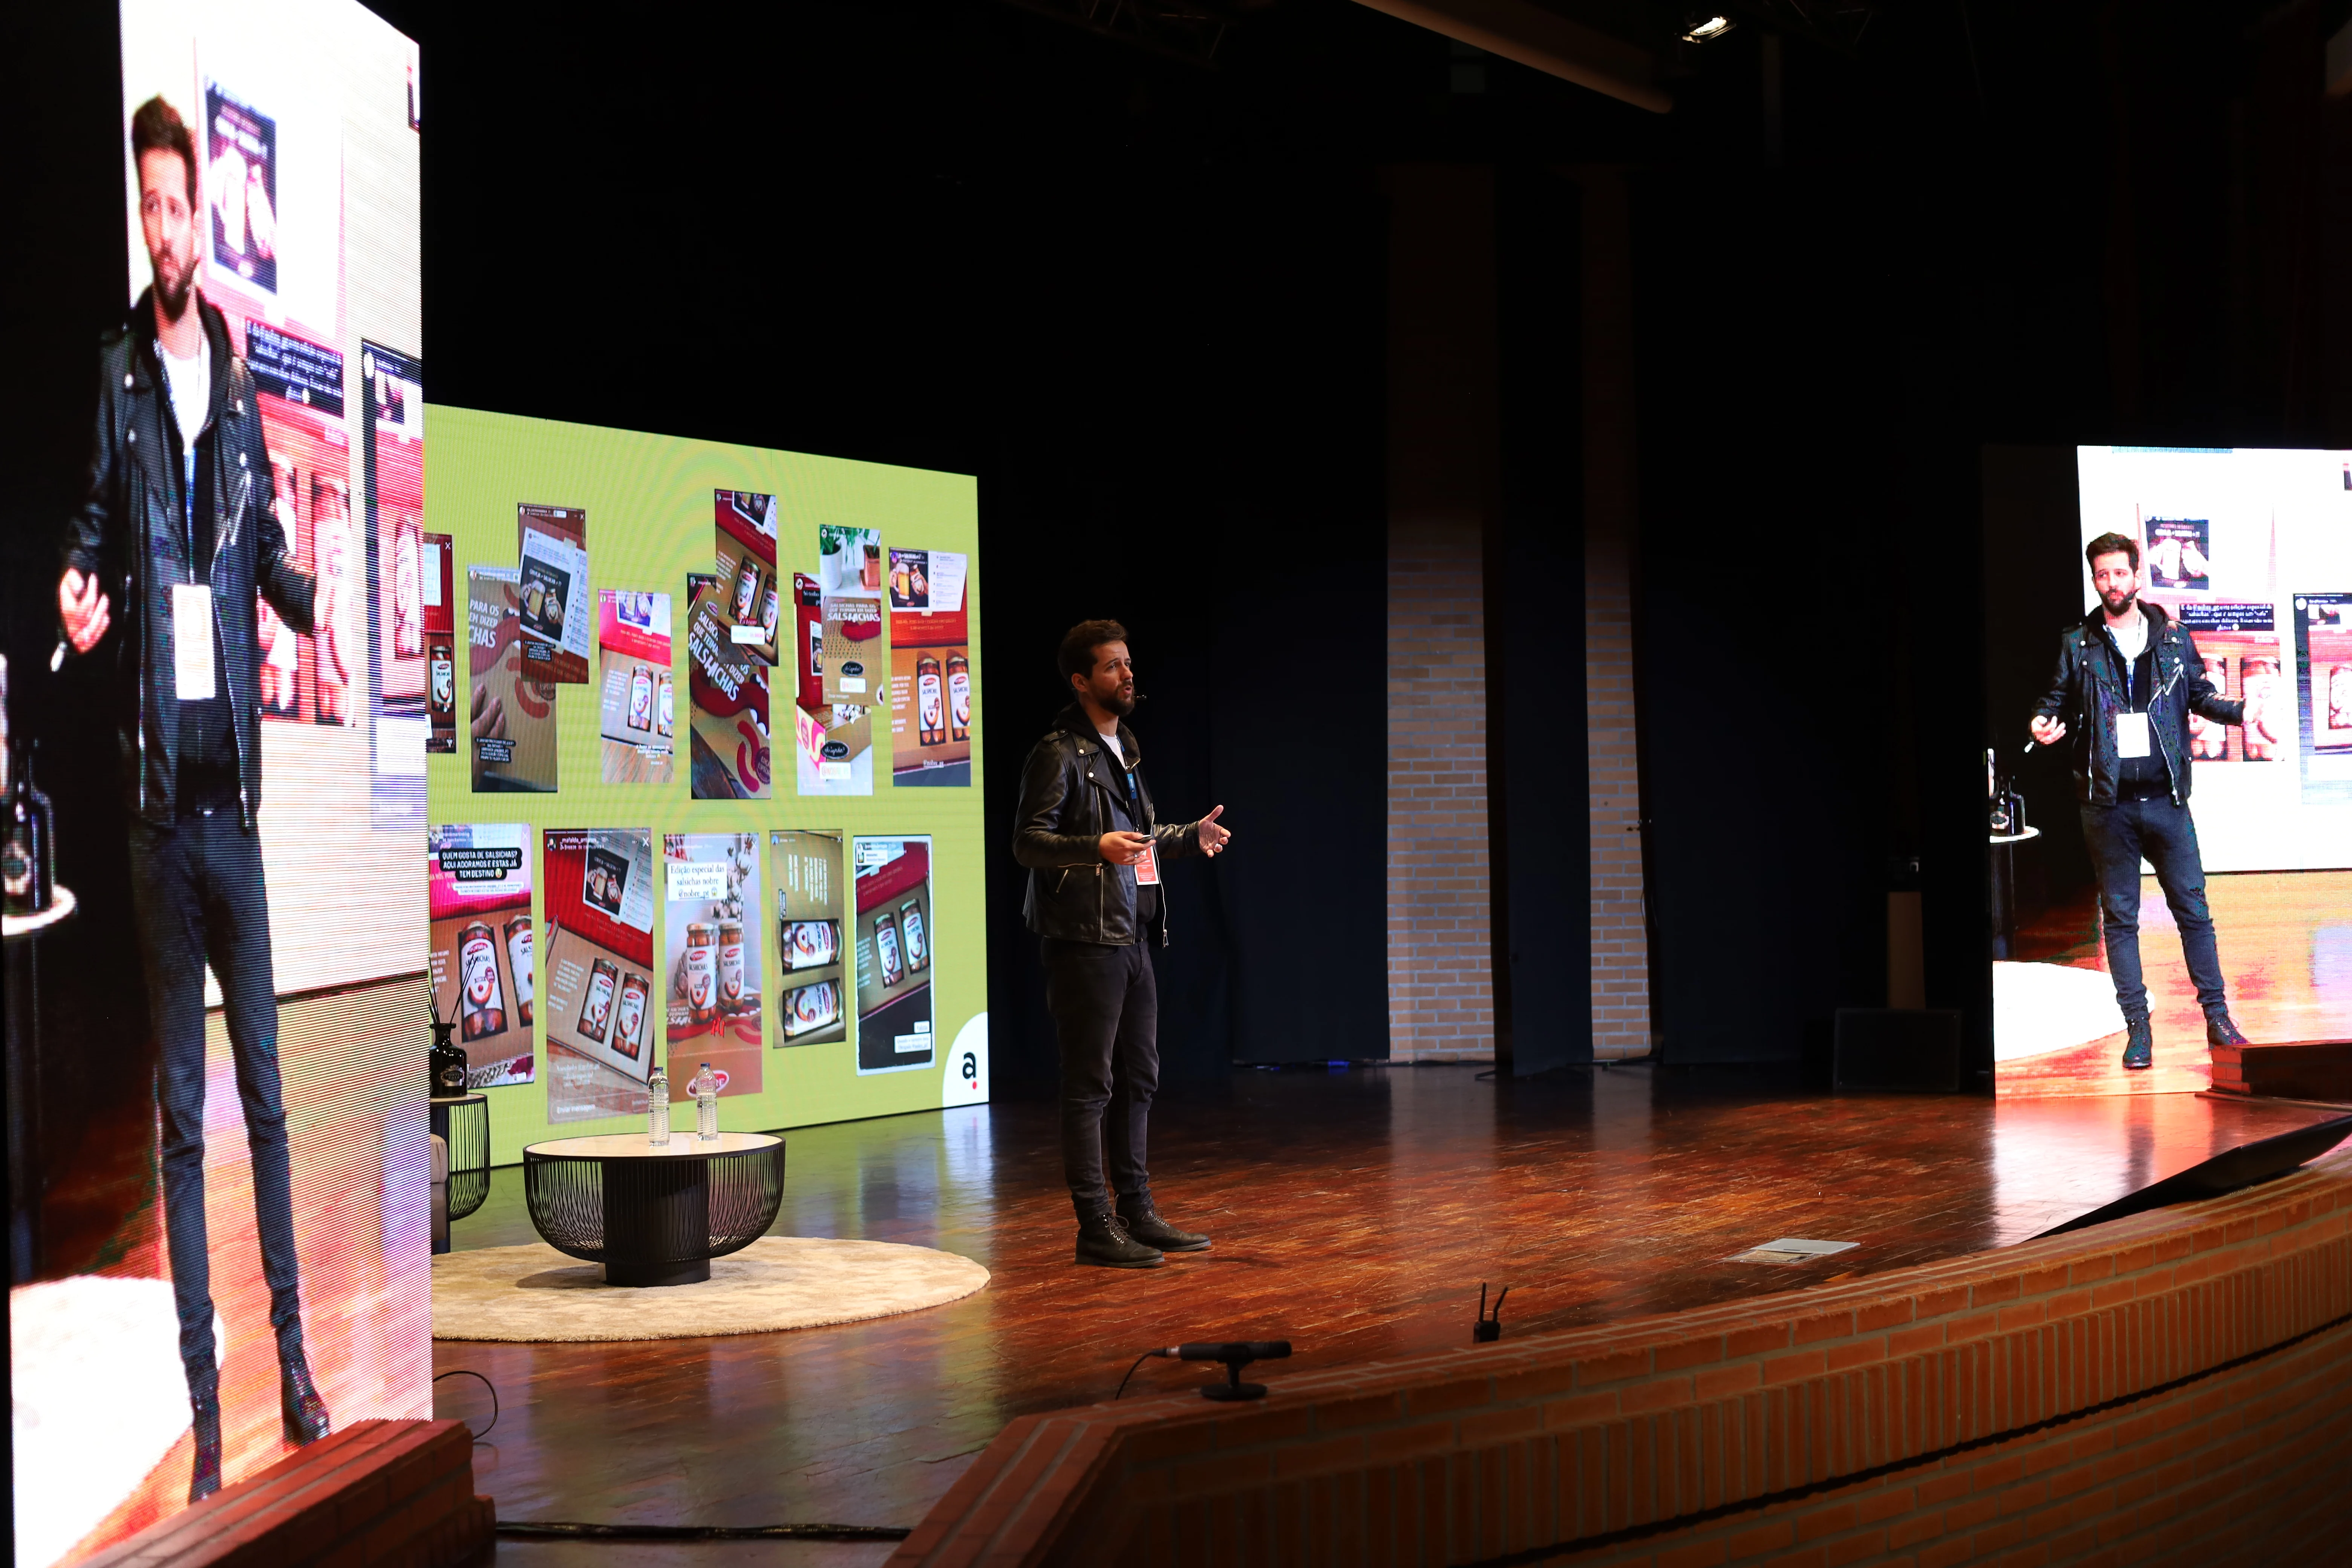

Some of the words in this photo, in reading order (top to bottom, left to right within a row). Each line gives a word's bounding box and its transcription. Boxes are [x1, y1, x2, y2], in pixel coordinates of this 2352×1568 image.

[470, 599, 487, 614] PARA
[490, 605, 499, 616] OS
[480, 614, 498, 629] DIZER
[693, 621, 705, 638] QUE
[729, 663, 745, 684] DIZER
[442, 851, 458, 860] QUEM
[458, 851, 476, 860] GOSTA
[477, 850, 484, 860] DE
[485, 850, 518, 859] SALSICHAS?
[457, 860, 487, 868] ADORAMOS
[492, 859, 509, 868] ESTAS
[510, 858, 517, 867] JÁ
[459, 870, 471, 878] TEM
[472, 869, 494, 878] DESTINO
[671, 865, 690, 876] Edição
[692, 864, 714, 876] especial
[715, 864, 724, 873] das
[677, 877, 701, 885] salsichas
[703, 876, 719, 885] nobre
